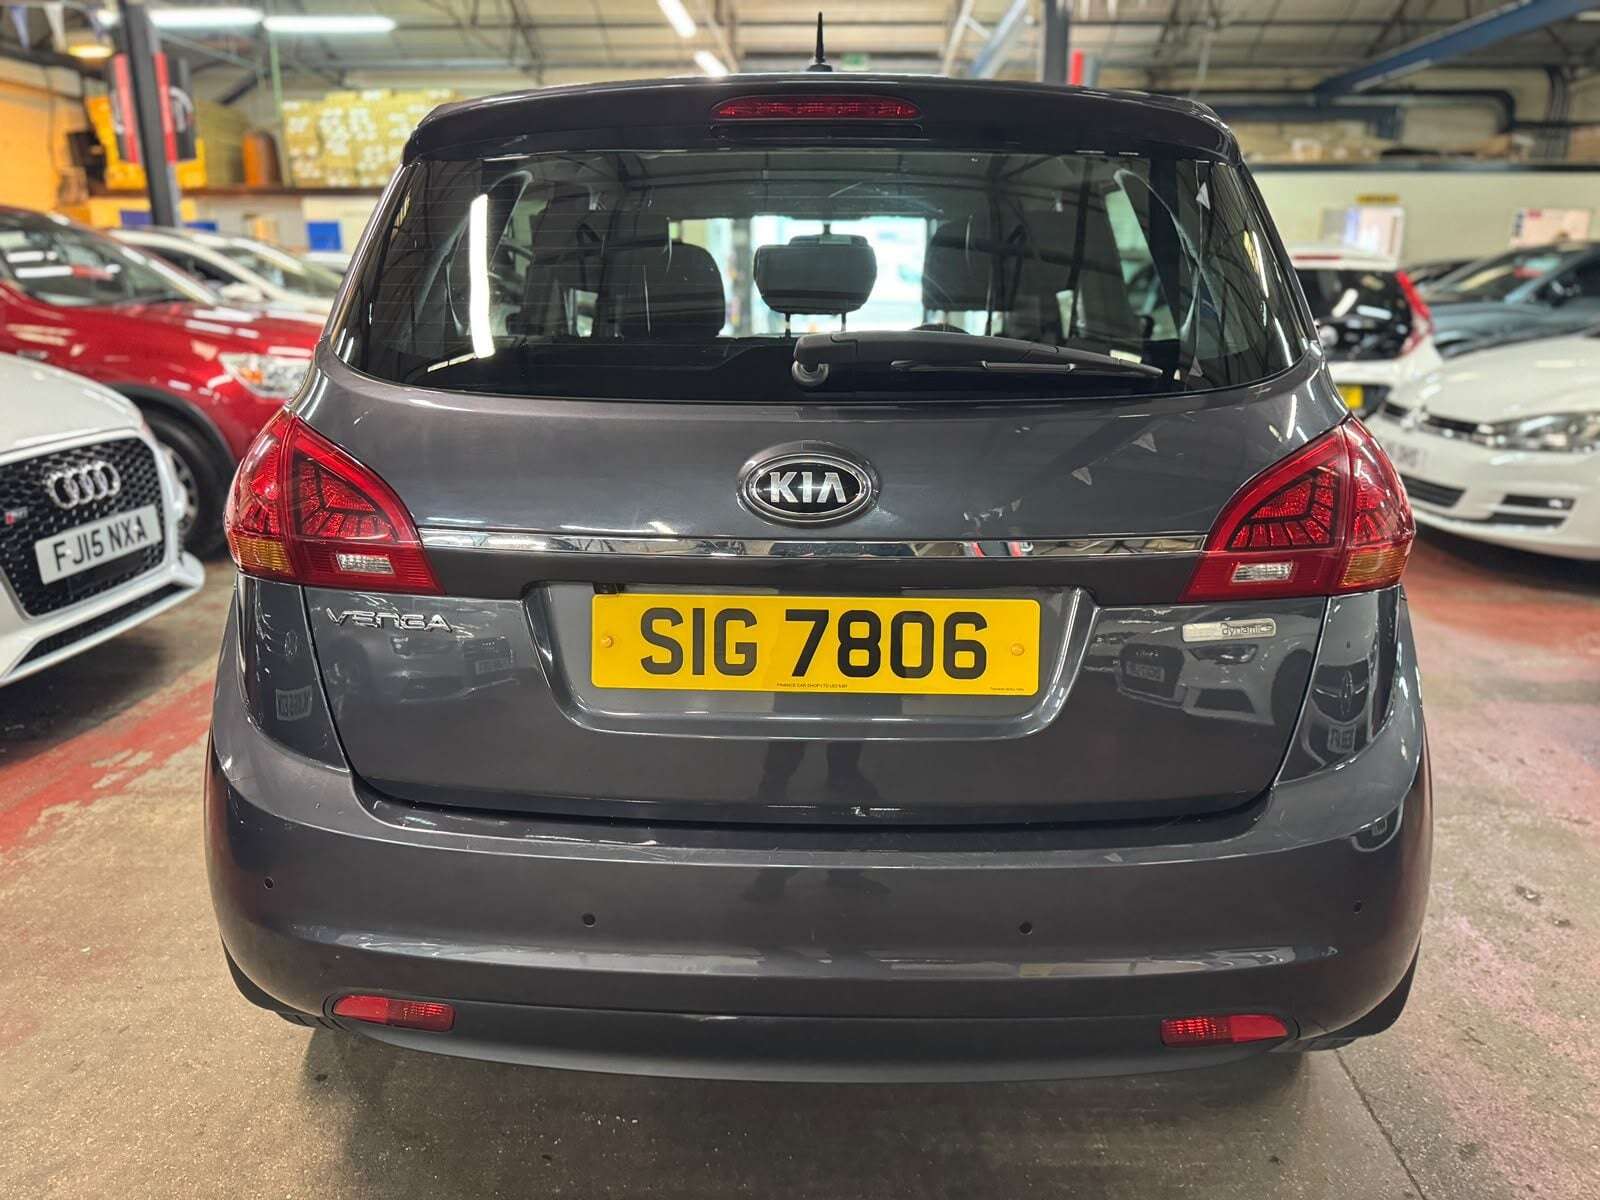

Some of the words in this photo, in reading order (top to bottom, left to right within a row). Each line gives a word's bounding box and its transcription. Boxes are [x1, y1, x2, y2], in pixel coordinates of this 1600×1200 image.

[769, 471, 846, 503] KIA
[53, 529, 104, 571] FJ15
[108, 515, 148, 552] NXA
[326, 607, 453, 633] VENGA
[640, 607, 758, 676] SIG
[785, 608, 987, 680] 7806
